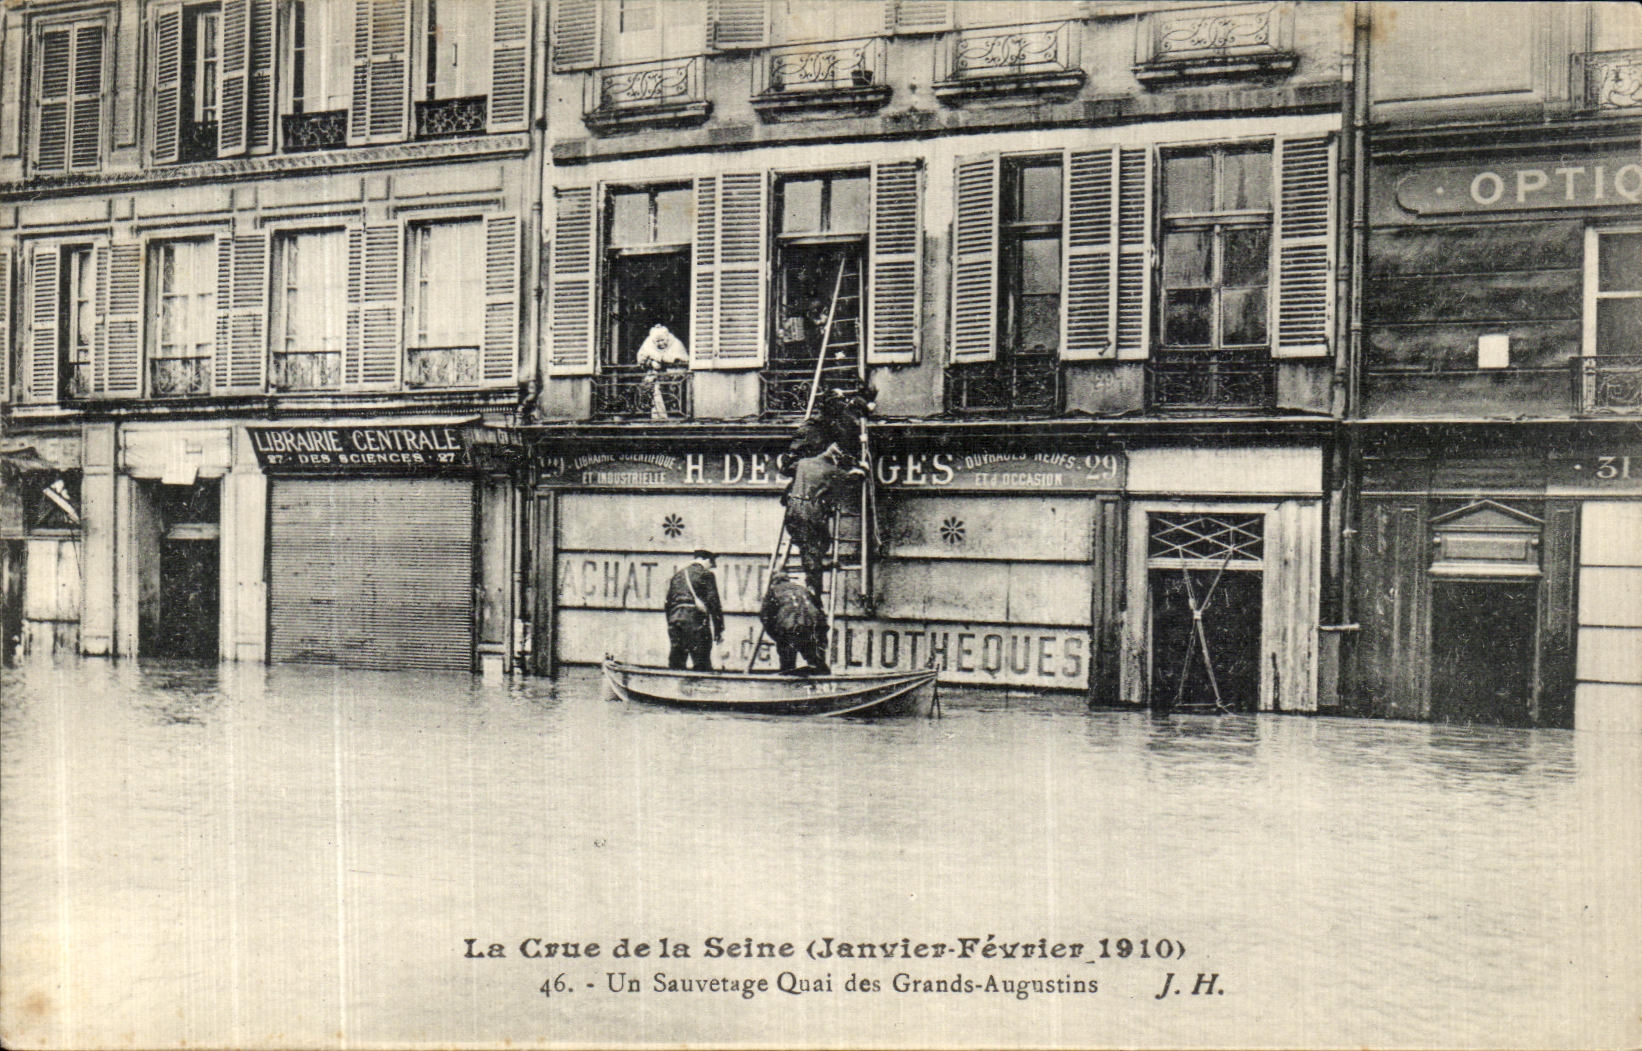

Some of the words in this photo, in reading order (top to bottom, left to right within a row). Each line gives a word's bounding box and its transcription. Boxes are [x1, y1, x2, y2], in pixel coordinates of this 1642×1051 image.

[254, 430, 343, 452] LIBRAIRIE
[351, 428, 461, 451] CENTRALE
[299, 454, 331, 464] DES
[339, 453, 425, 464] SCIENCES
[438, 452, 455, 462] 27
[1084, 454, 1118, 480] 29
[1596, 456, 1631, 478] 31
[582, 472, 594, 484] ET
[598, 471, 666, 485] INDUSTRIELLE
[559, 560, 658, 600] ACHAT
